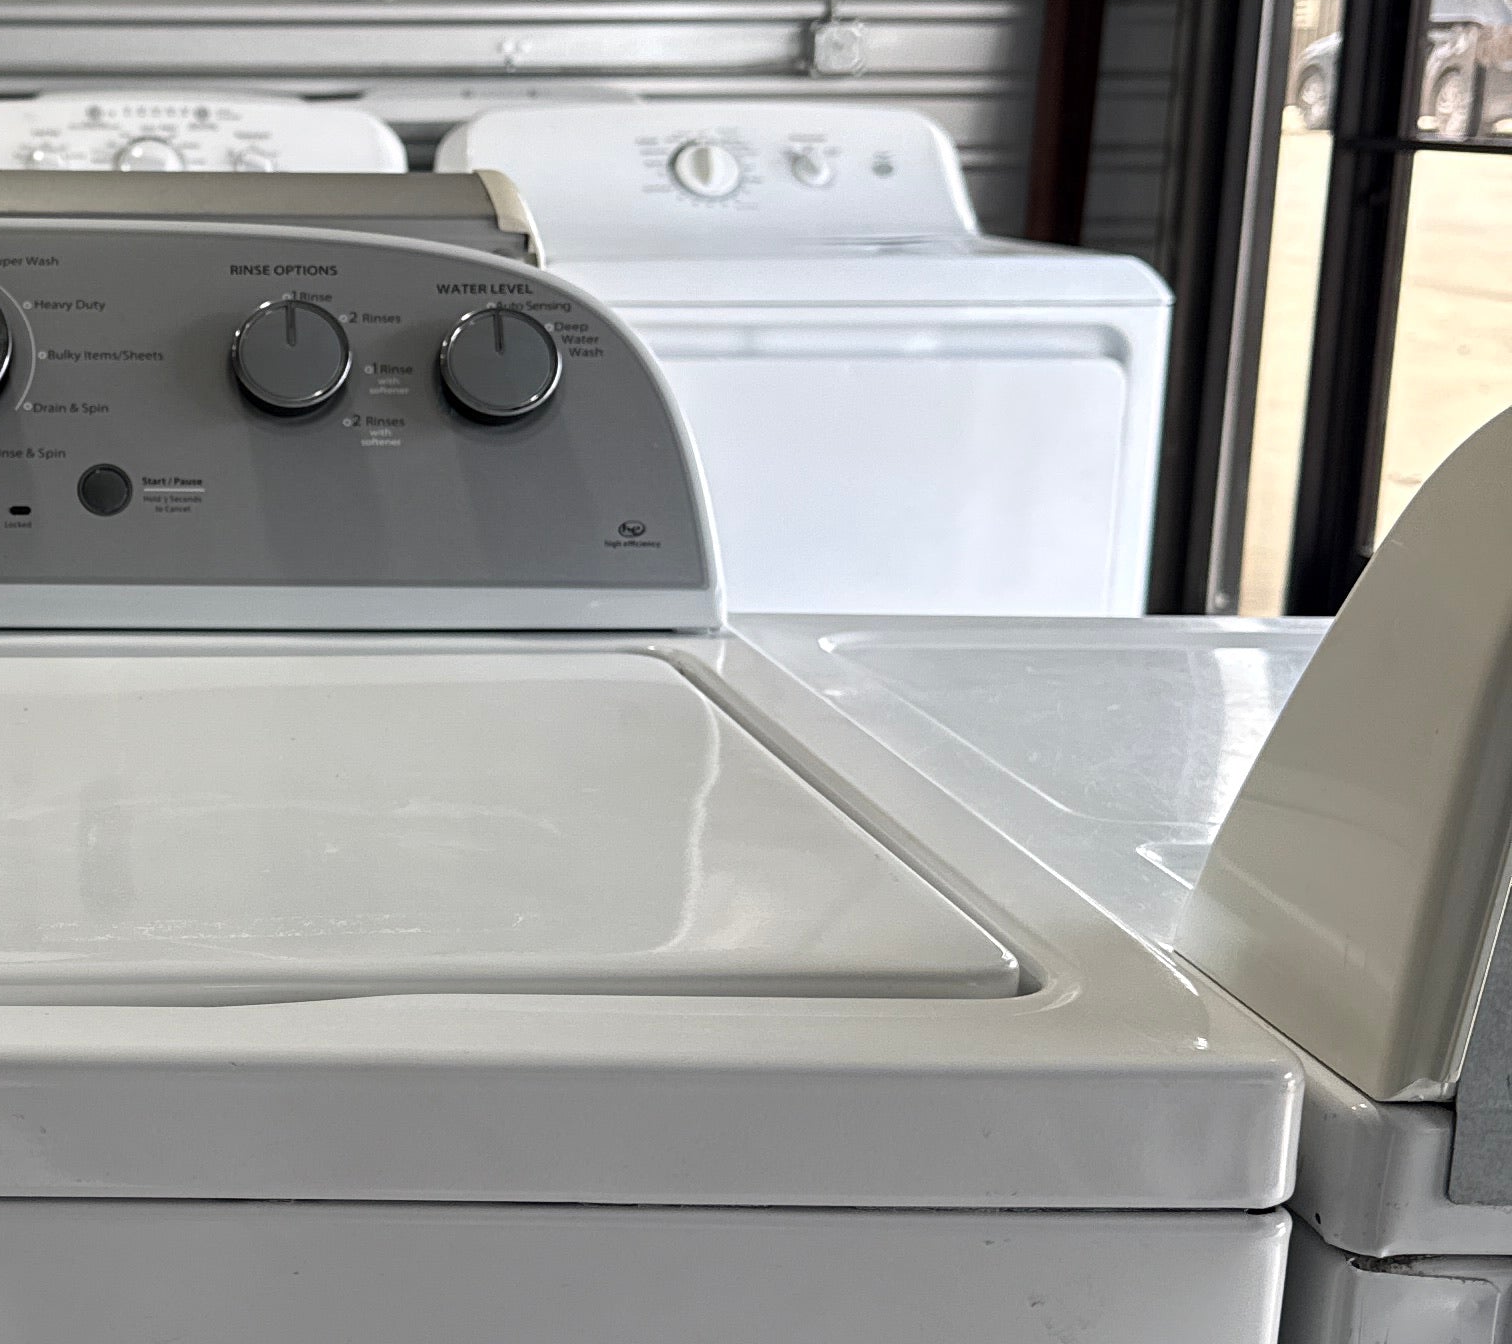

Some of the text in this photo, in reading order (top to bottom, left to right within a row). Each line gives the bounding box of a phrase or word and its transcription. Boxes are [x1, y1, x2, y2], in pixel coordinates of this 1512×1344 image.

[26, 256, 59, 267] Wash
[230, 265, 338, 276] RINSE OPTIONS
[436, 283, 534, 295] WATER LEVEL
[292, 291, 333, 303] 1 Rinse
[34, 299, 106, 312] Heavy Duty
[496, 301, 572, 314] Auto Sensing
[349, 312, 401, 324] 2 Rinses
[554, 322, 589, 336] Deep
[561, 334, 599, 345] Water
[47, 349, 163, 362] Bulky Items/Sheets
[569, 347, 604, 358] Wash
[372, 363, 413, 375] 1 Rinse
[378, 376, 400, 386] with
[369, 386, 410, 395] softener
[33, 402, 109, 415] Drain & Spin
[352, 416, 405, 427] 2 Rinses
[370, 428, 392, 437] with
[361, 437, 402, 446] softener
[25, 447, 35, 459] &
[38, 447, 66, 461] Spin
[142, 477, 167, 486] Start
[173, 477, 203, 486] Pause
[4, 520, 32, 529] Locked
